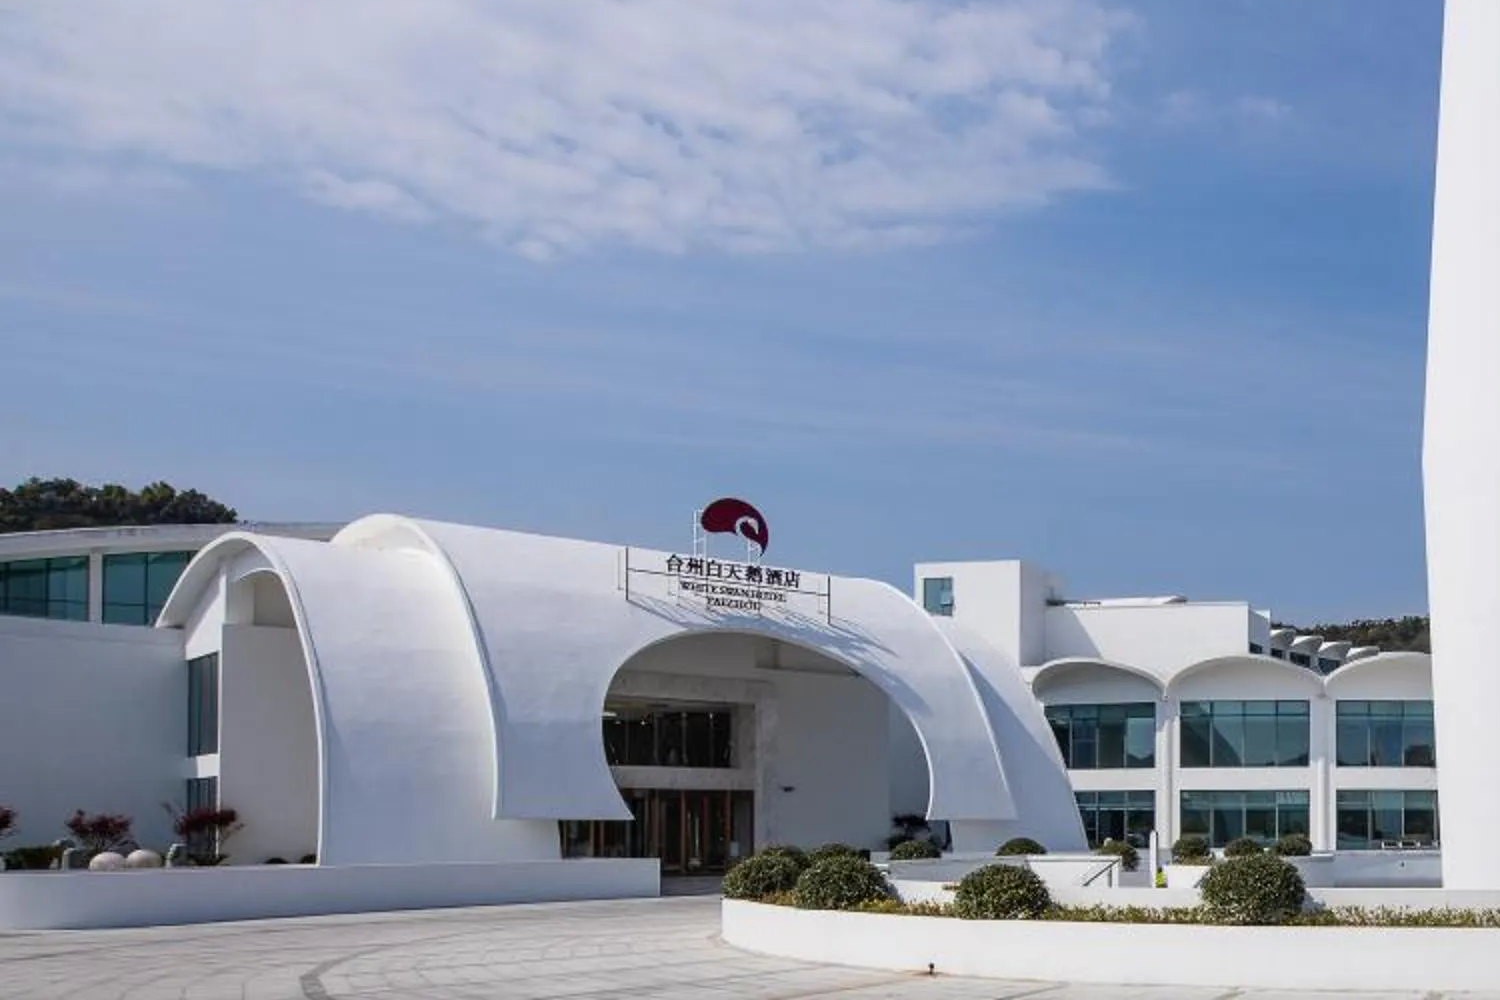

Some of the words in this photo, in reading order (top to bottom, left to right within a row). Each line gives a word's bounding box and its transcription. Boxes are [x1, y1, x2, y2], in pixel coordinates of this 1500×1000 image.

[666, 554, 800, 588] 台州白天鹅酒店
